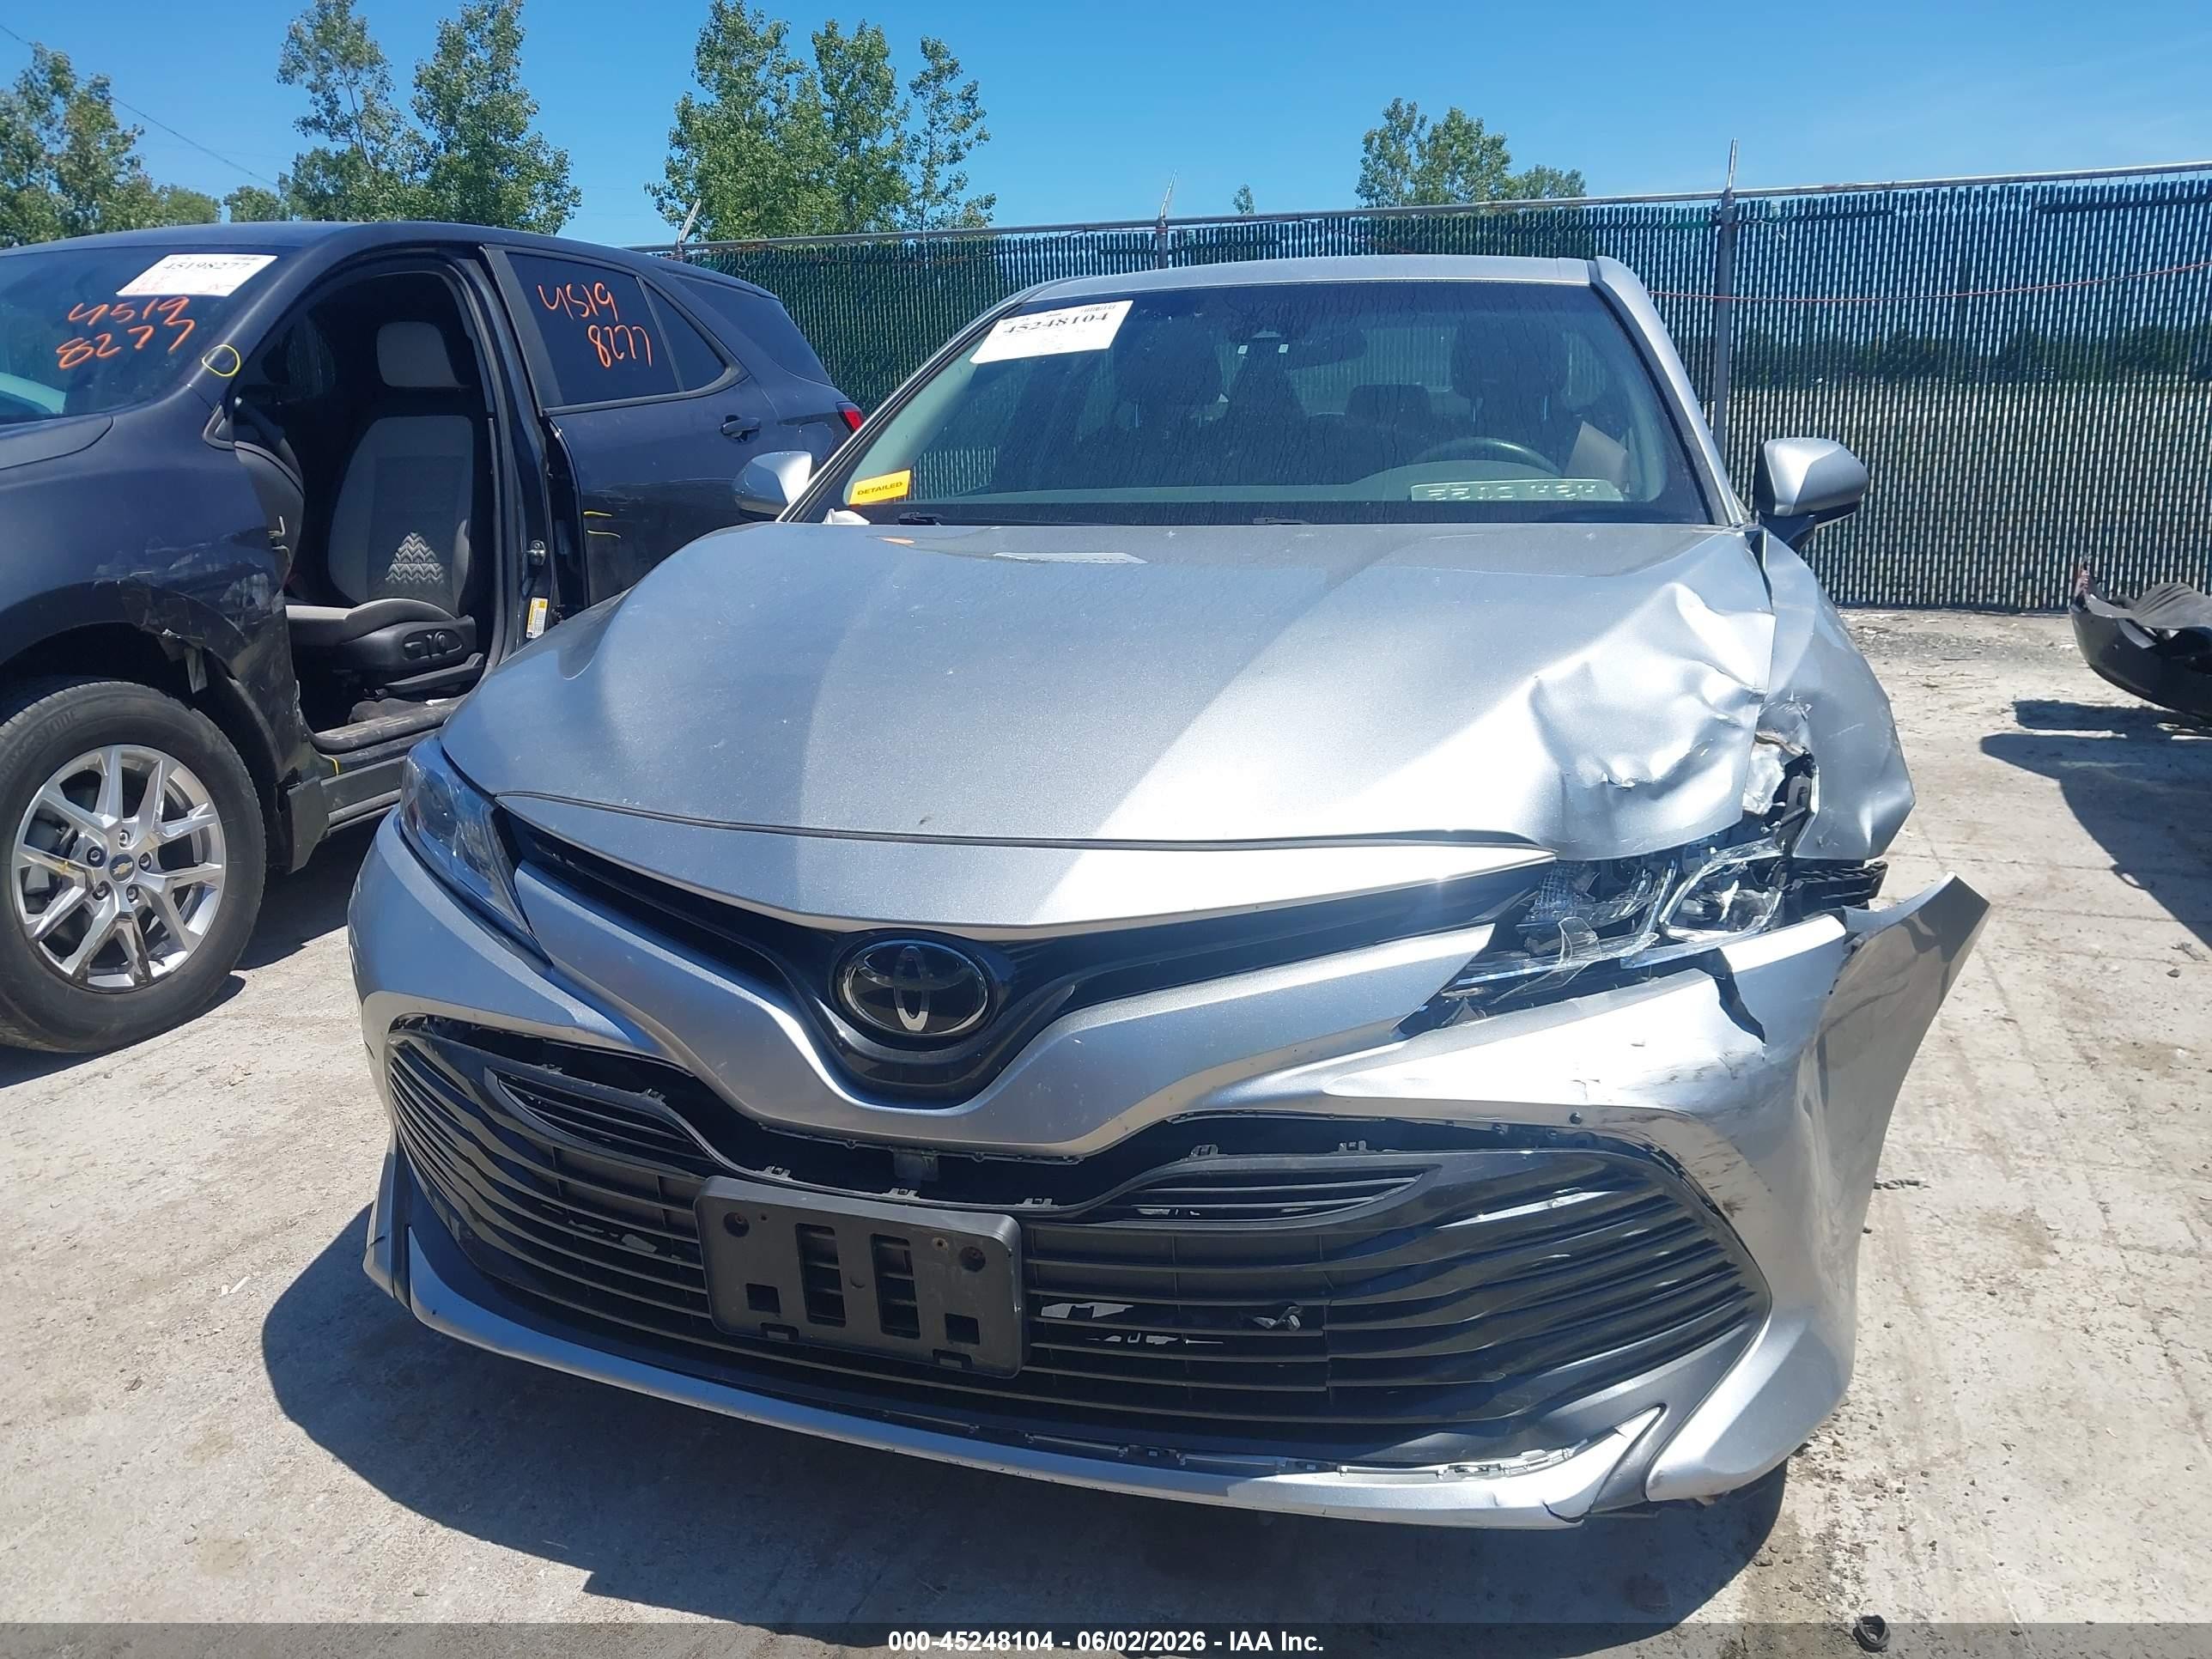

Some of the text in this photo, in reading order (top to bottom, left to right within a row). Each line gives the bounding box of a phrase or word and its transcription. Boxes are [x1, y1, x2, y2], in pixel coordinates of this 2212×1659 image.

[67, 295, 190, 326] 4519
[538, 282, 619, 323] 4519
[1003, 312, 1109, 334] 45248104
[857, 481, 903, 495] DETAILED
